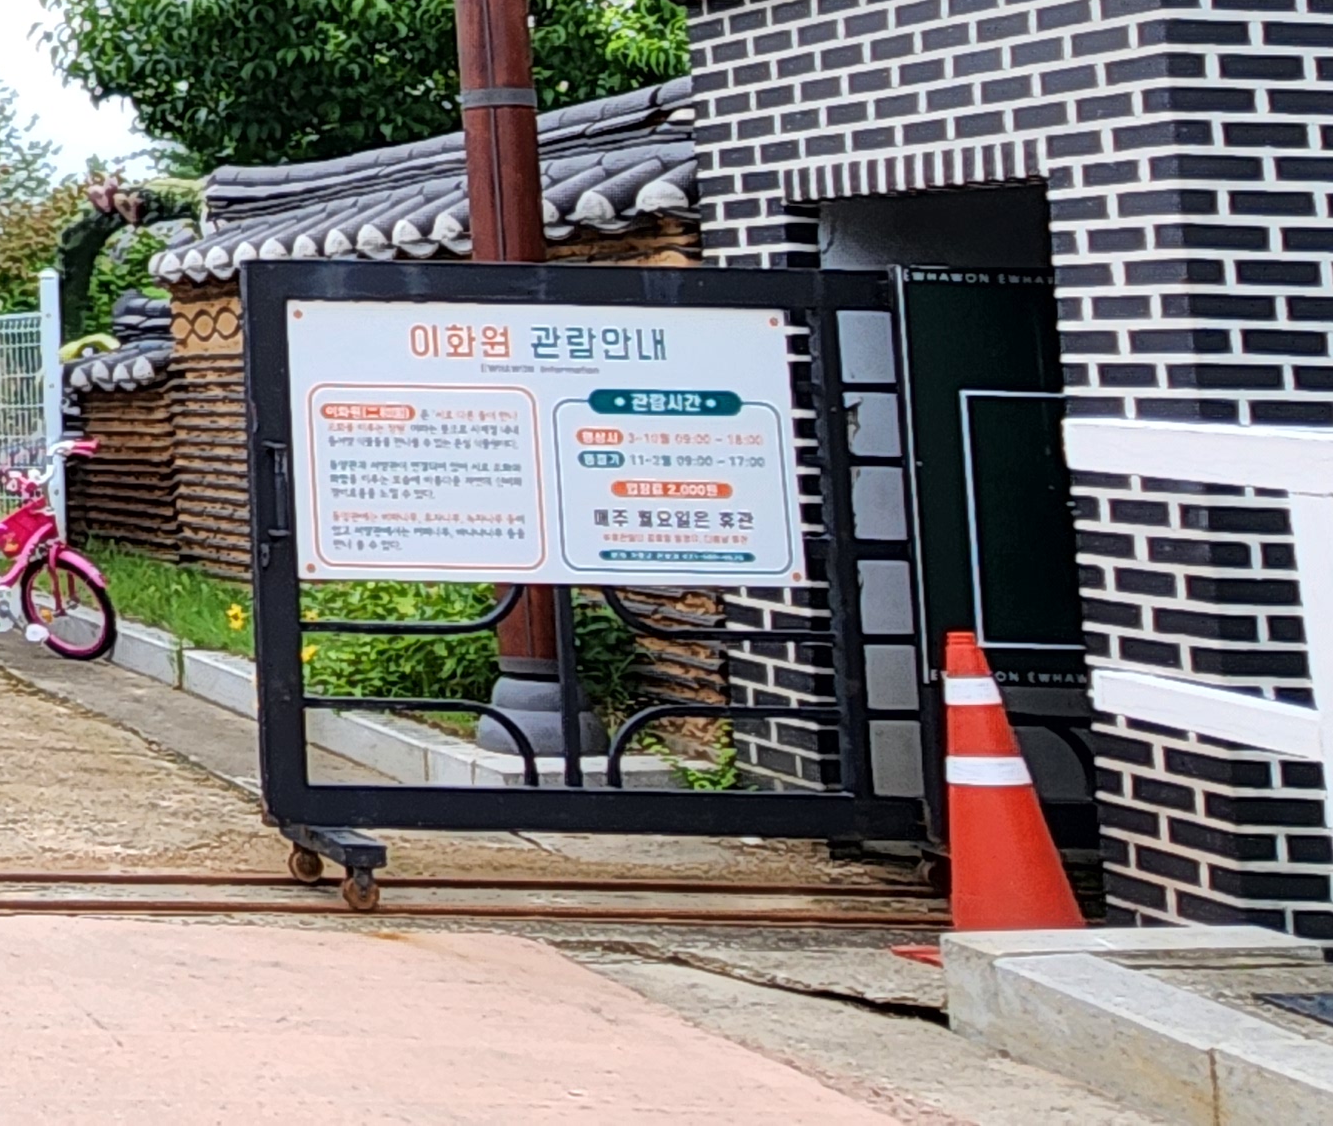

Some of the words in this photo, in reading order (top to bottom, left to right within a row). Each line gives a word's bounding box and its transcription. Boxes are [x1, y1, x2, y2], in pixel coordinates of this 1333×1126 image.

[409, 323, 511, 359] 이화원
[530, 325, 668, 361] 관람안내
[631, 392, 703, 413] 관람시간
[593, 509, 629, 528] 매주
[637, 509, 711, 530] 월요일은
[718, 511, 755, 531] 휴관
